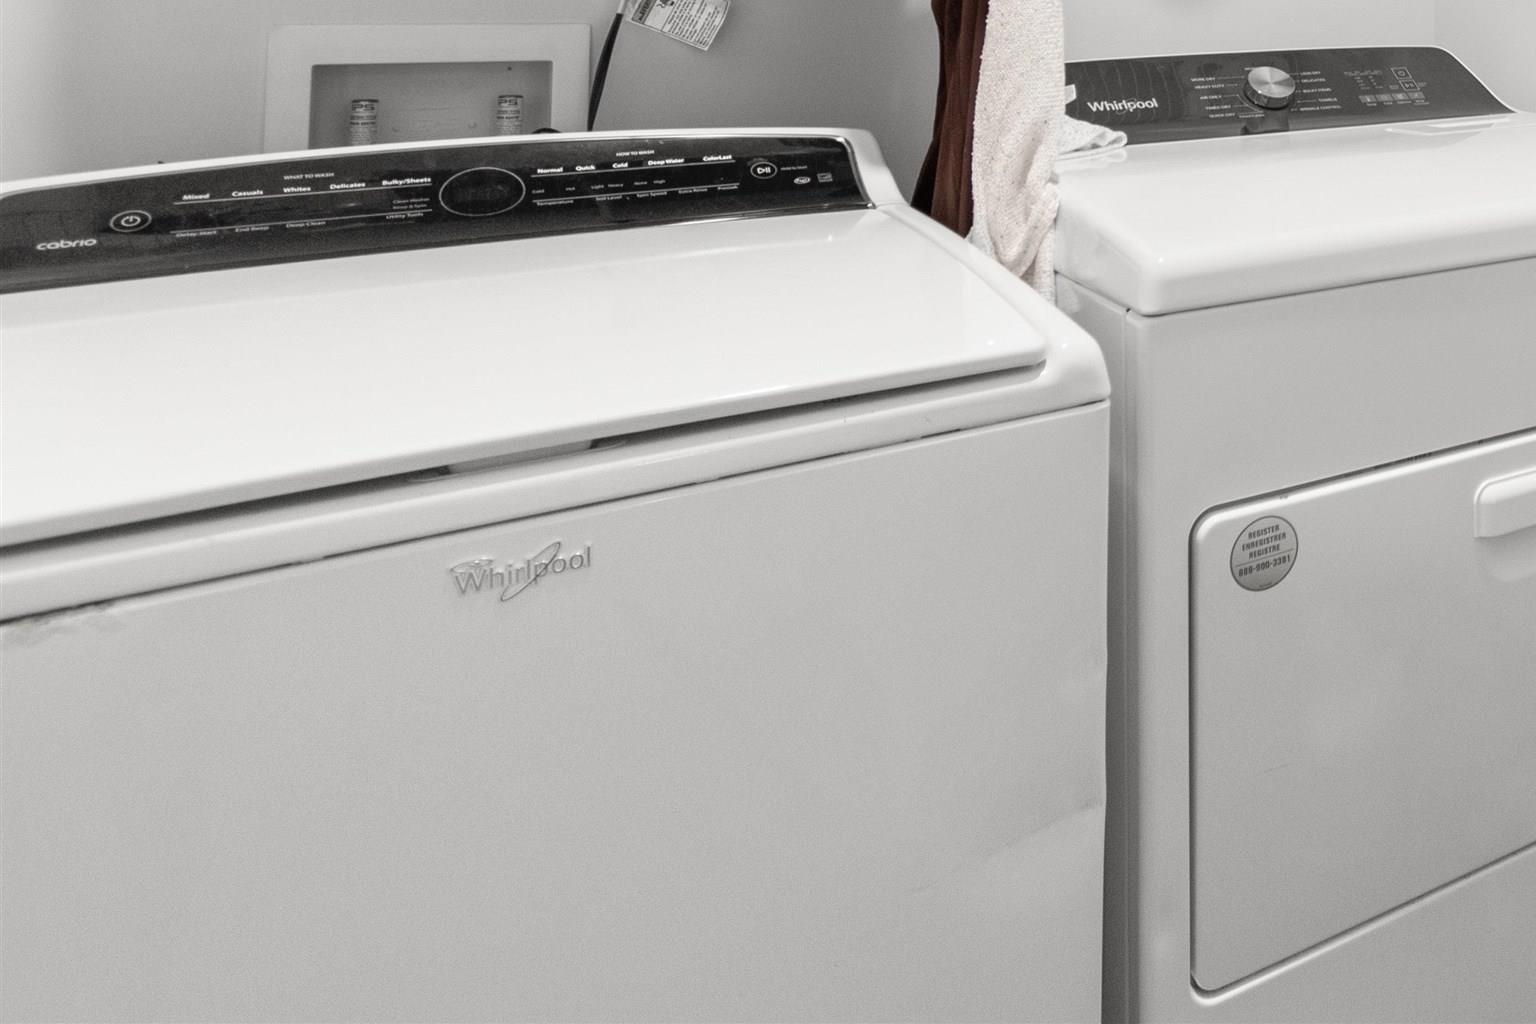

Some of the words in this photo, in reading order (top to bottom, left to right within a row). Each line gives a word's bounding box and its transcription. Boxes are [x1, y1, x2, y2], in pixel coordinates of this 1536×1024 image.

[1087, 98, 1159, 113] Whirlpool
[536, 166, 564, 174] Normal
[612, 161, 629, 169] Cold
[702, 154, 733, 162] ColorLast
[182, 192, 210, 201] Mixed
[231, 189, 264, 197] Casuals
[282, 185, 312, 194] Whites
[329, 182, 366, 190] Delicates
[381, 177, 432, 186] Bulky/Sheets
[36, 237, 98, 251] cabrio
[1241, 532, 1287, 552] ENREGISTRER
[1247, 524, 1280, 540] REGISTER
[455, 544, 592, 596] Whirlpool
